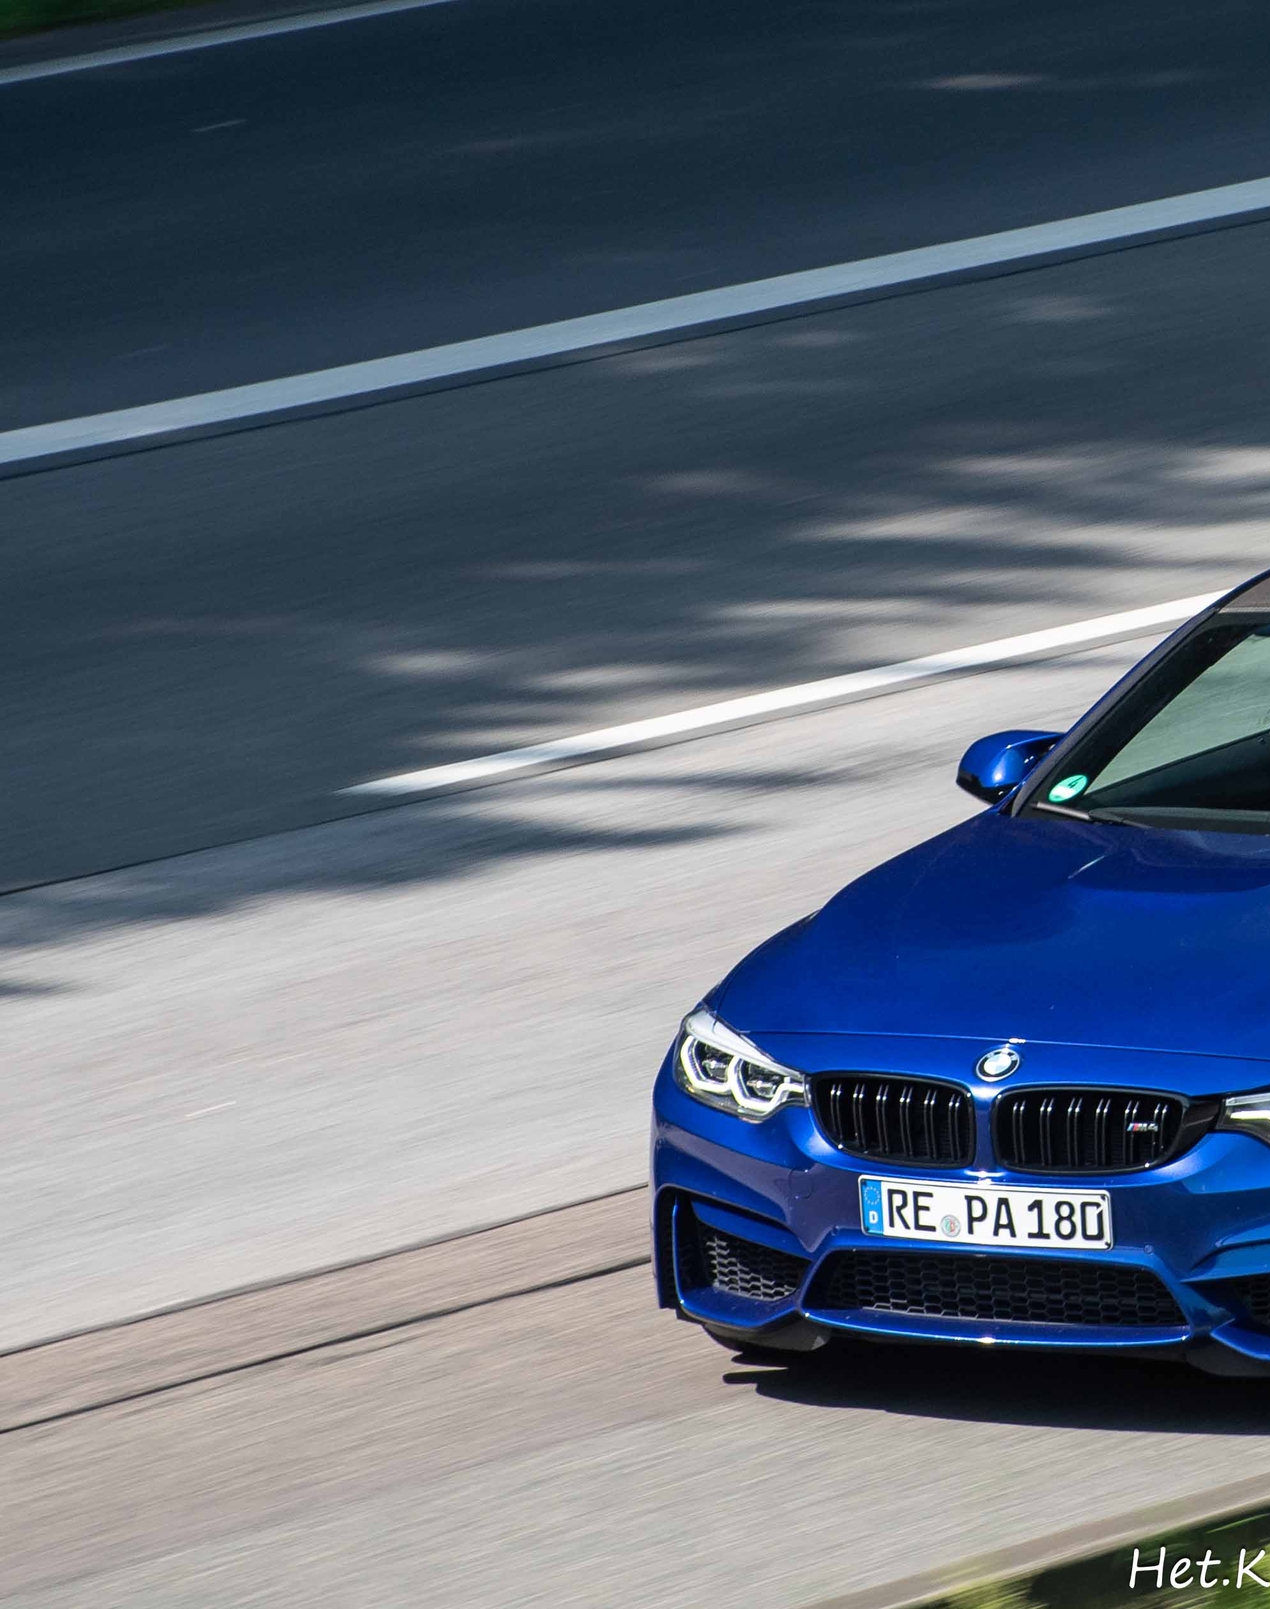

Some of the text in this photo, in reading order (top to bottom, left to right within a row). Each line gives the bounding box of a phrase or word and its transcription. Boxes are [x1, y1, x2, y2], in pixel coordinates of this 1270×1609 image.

[869, 1211, 878, 1223] D
[887, 1188, 1105, 1242] RE PA 180
